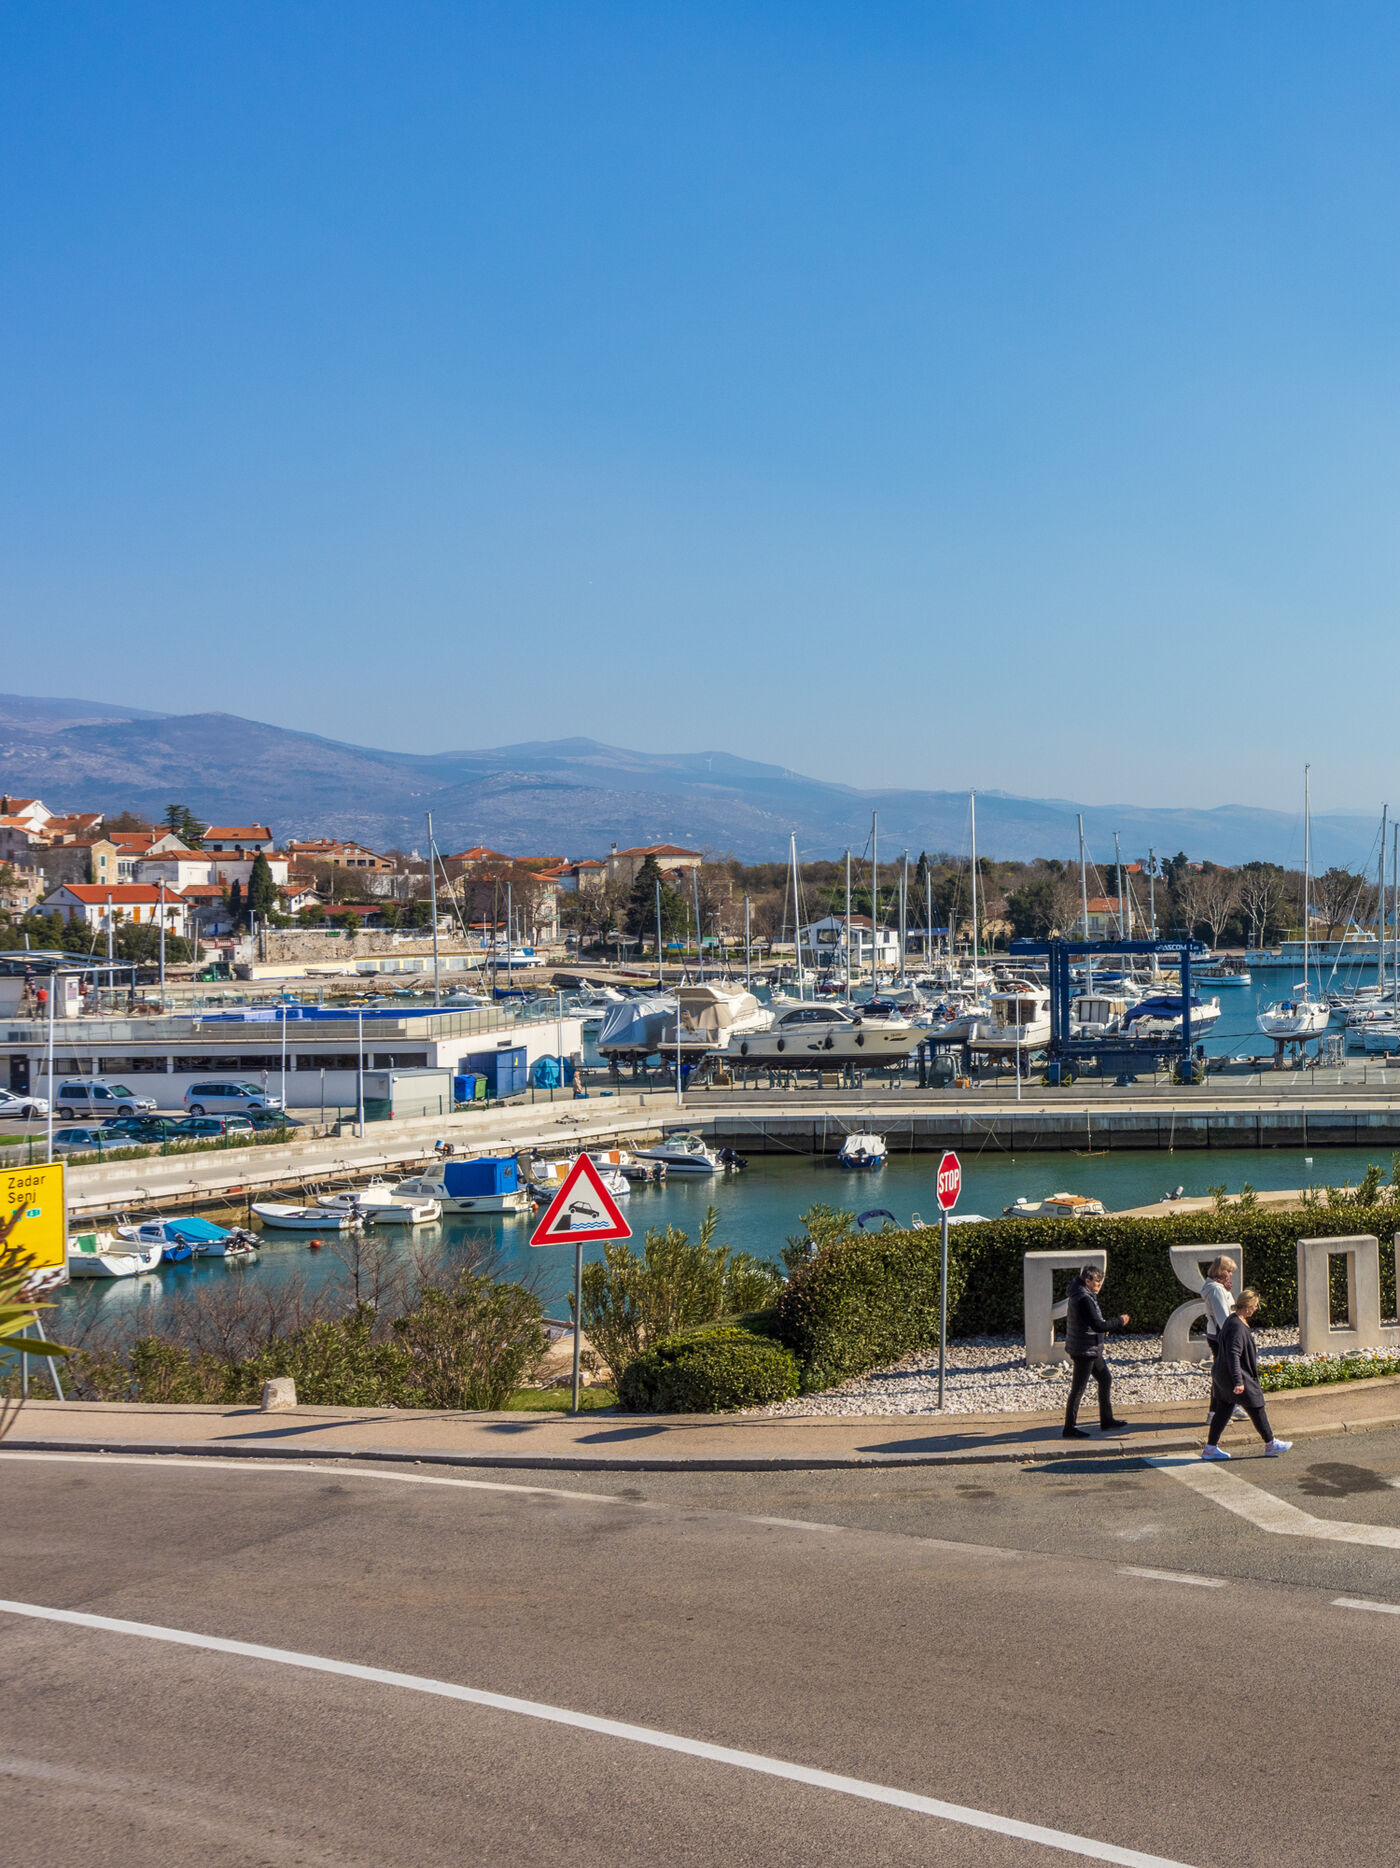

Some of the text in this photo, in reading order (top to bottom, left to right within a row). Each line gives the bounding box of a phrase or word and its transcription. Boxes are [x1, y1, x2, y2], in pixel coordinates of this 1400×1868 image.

[8, 1175, 46, 1189] Zadar
[938, 1168, 960, 1194] STOP
[8, 1190, 37, 1204] Senj
